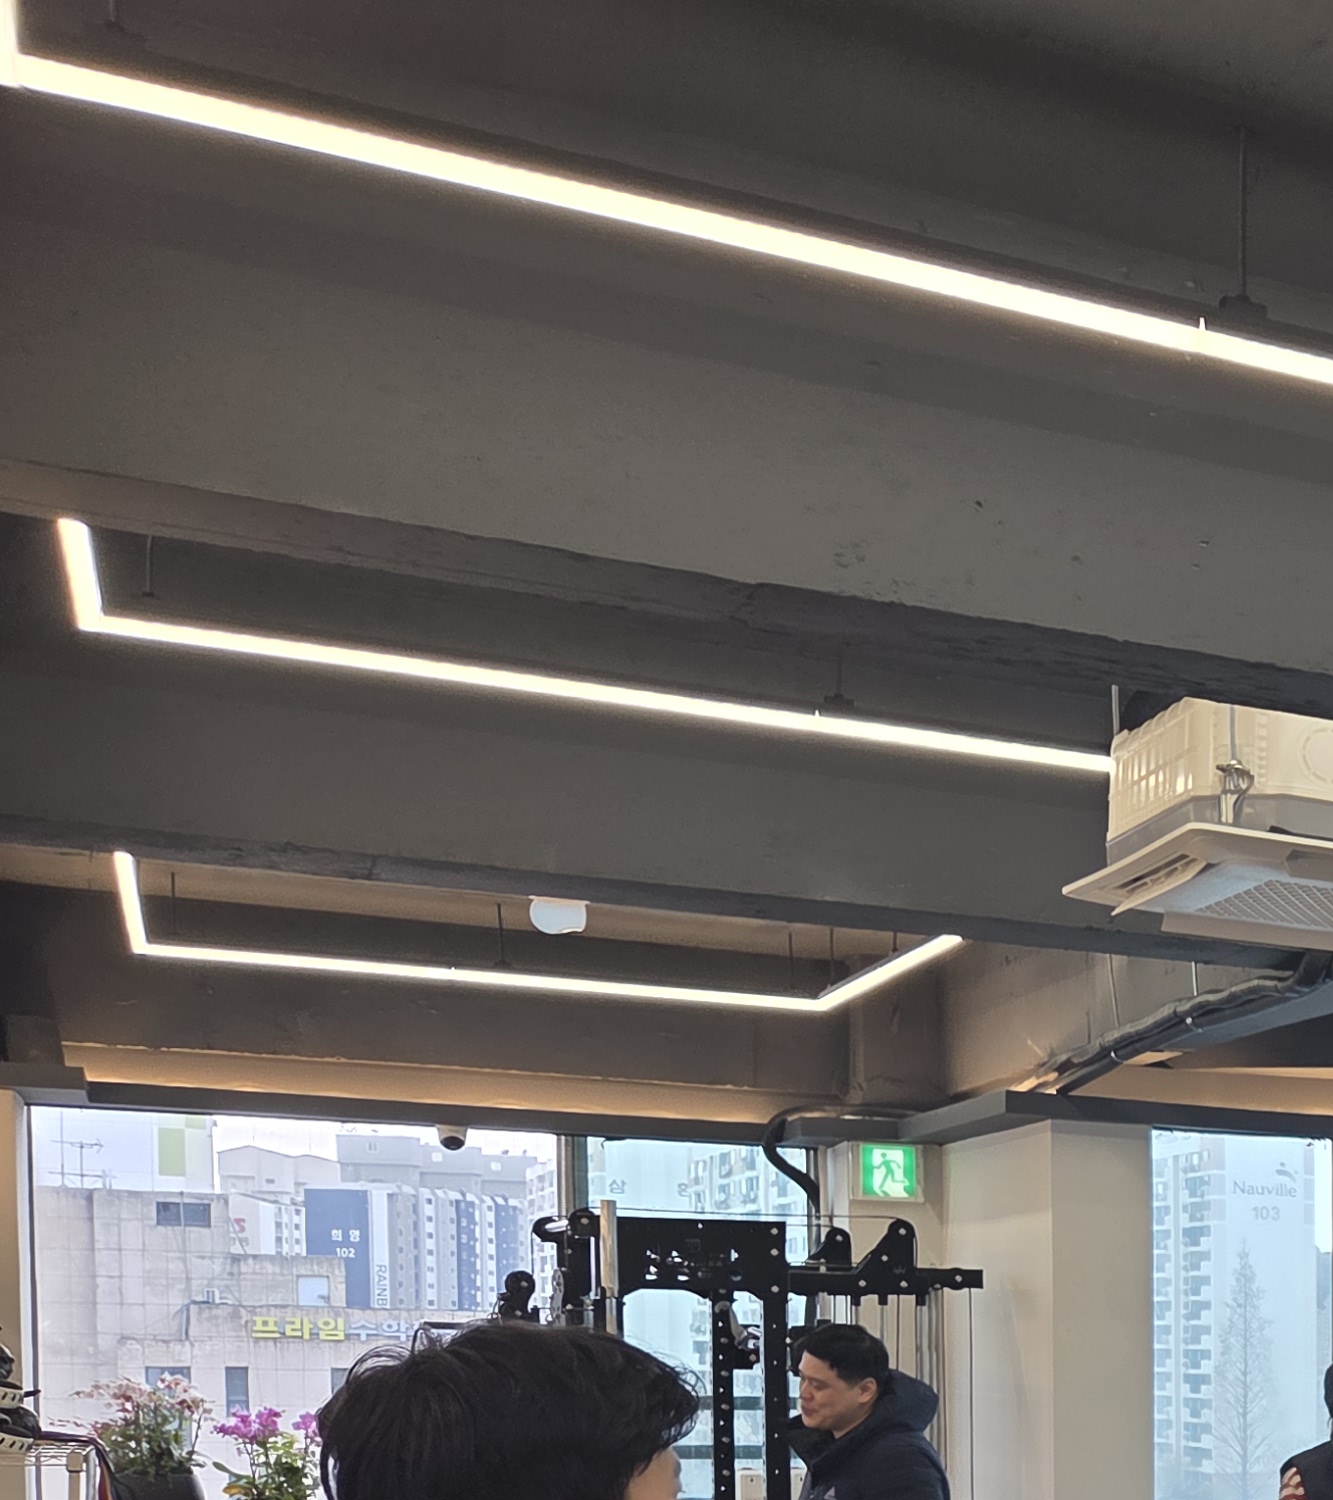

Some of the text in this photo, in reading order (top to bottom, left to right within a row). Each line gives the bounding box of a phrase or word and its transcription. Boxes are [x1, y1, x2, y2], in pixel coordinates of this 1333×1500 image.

[1233, 1180, 1297, 1198] Nauville
[1251, 1205, 1281, 1221] 103
[335, 1247, 356, 1258] 102
